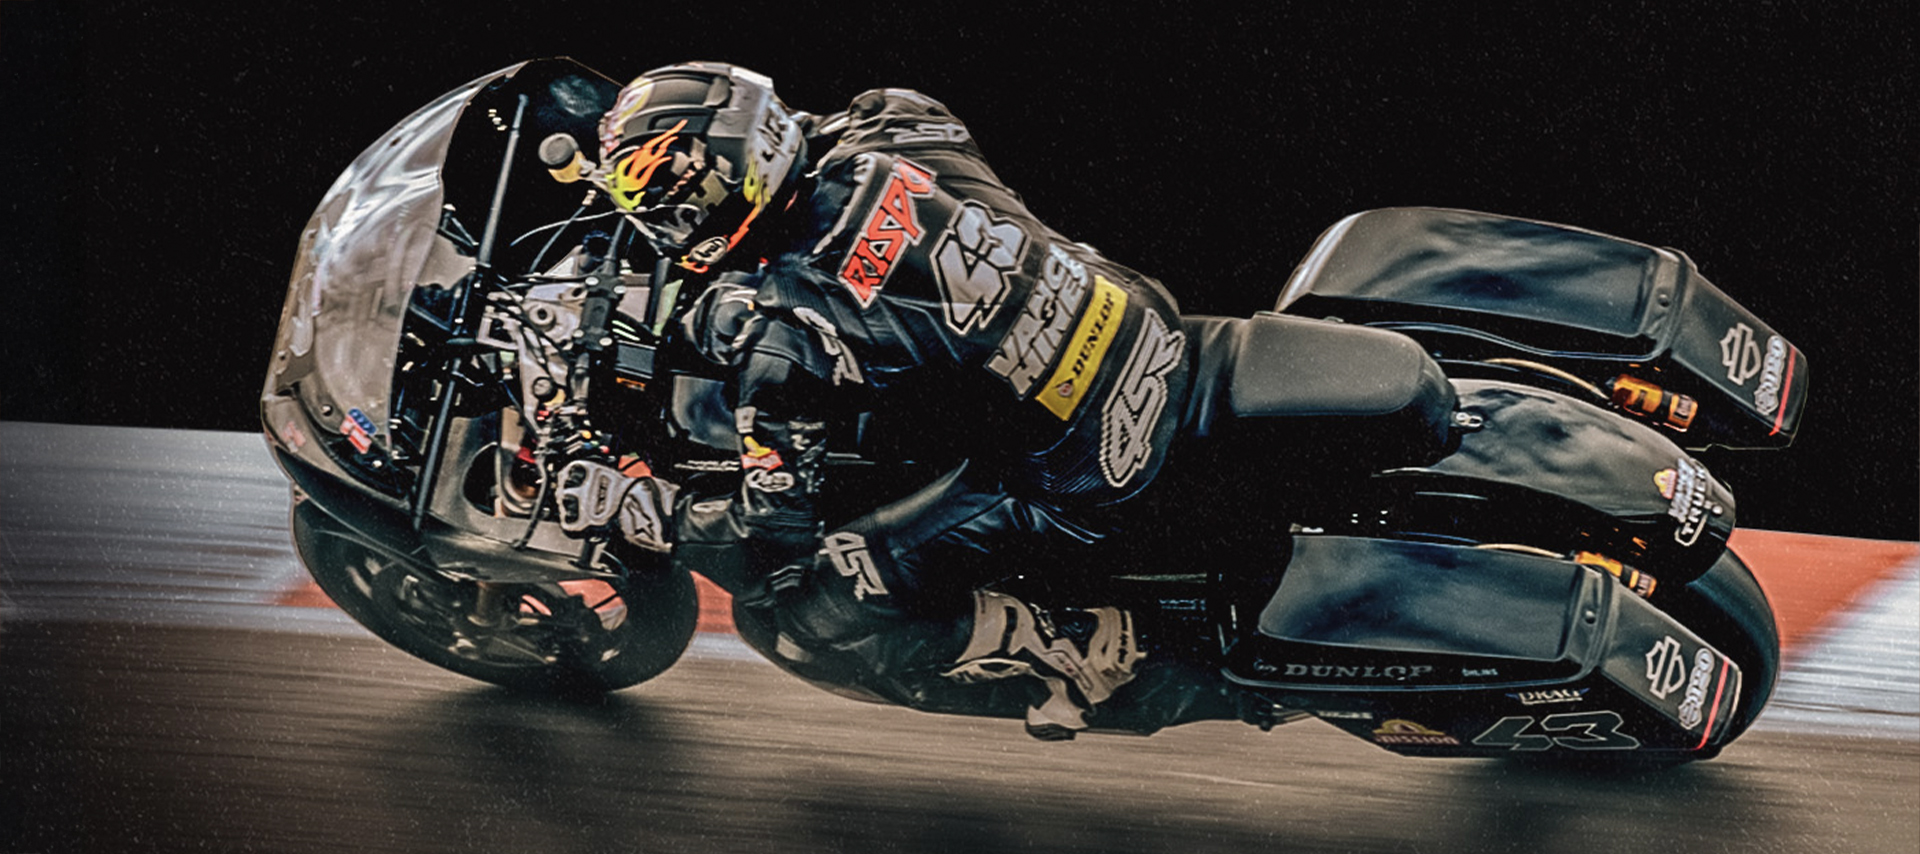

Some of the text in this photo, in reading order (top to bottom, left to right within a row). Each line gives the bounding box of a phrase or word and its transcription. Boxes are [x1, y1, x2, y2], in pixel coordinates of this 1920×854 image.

[931, 201, 1032, 334] 43
[1072, 296, 1115, 377] DUNLOP
[1284, 662, 1433, 680] DUNLOP
[1472, 710, 1640, 750] 43
